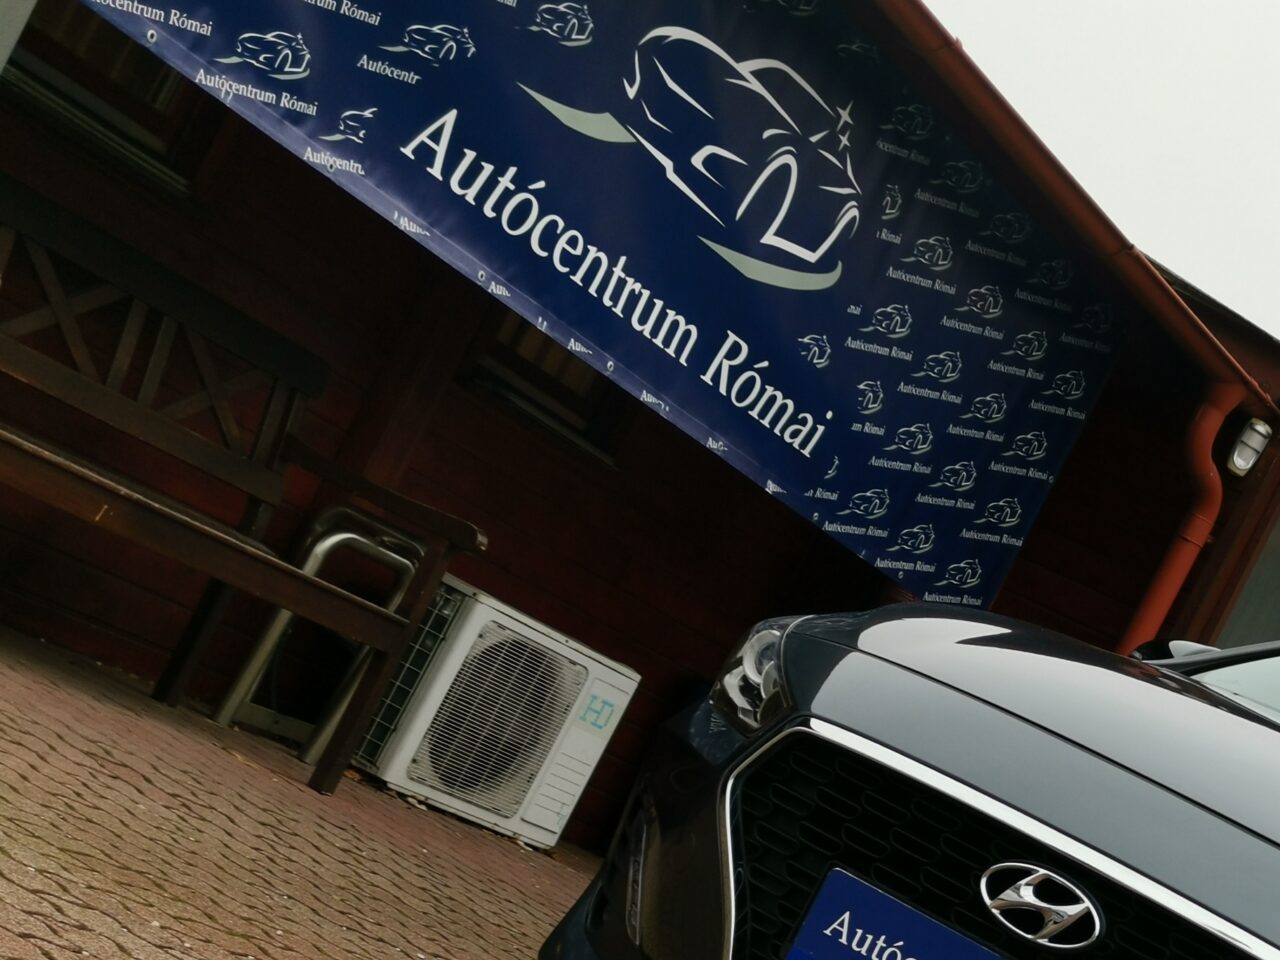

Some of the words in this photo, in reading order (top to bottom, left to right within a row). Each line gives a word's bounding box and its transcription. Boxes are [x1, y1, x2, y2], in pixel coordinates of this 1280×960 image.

[168, 9, 213, 36] Római
[340, 0, 382, 26] Római
[280, 92, 318, 116] Római
[401, 108, 697, 367] Autócentrum
[700, 330, 833, 458] Római
